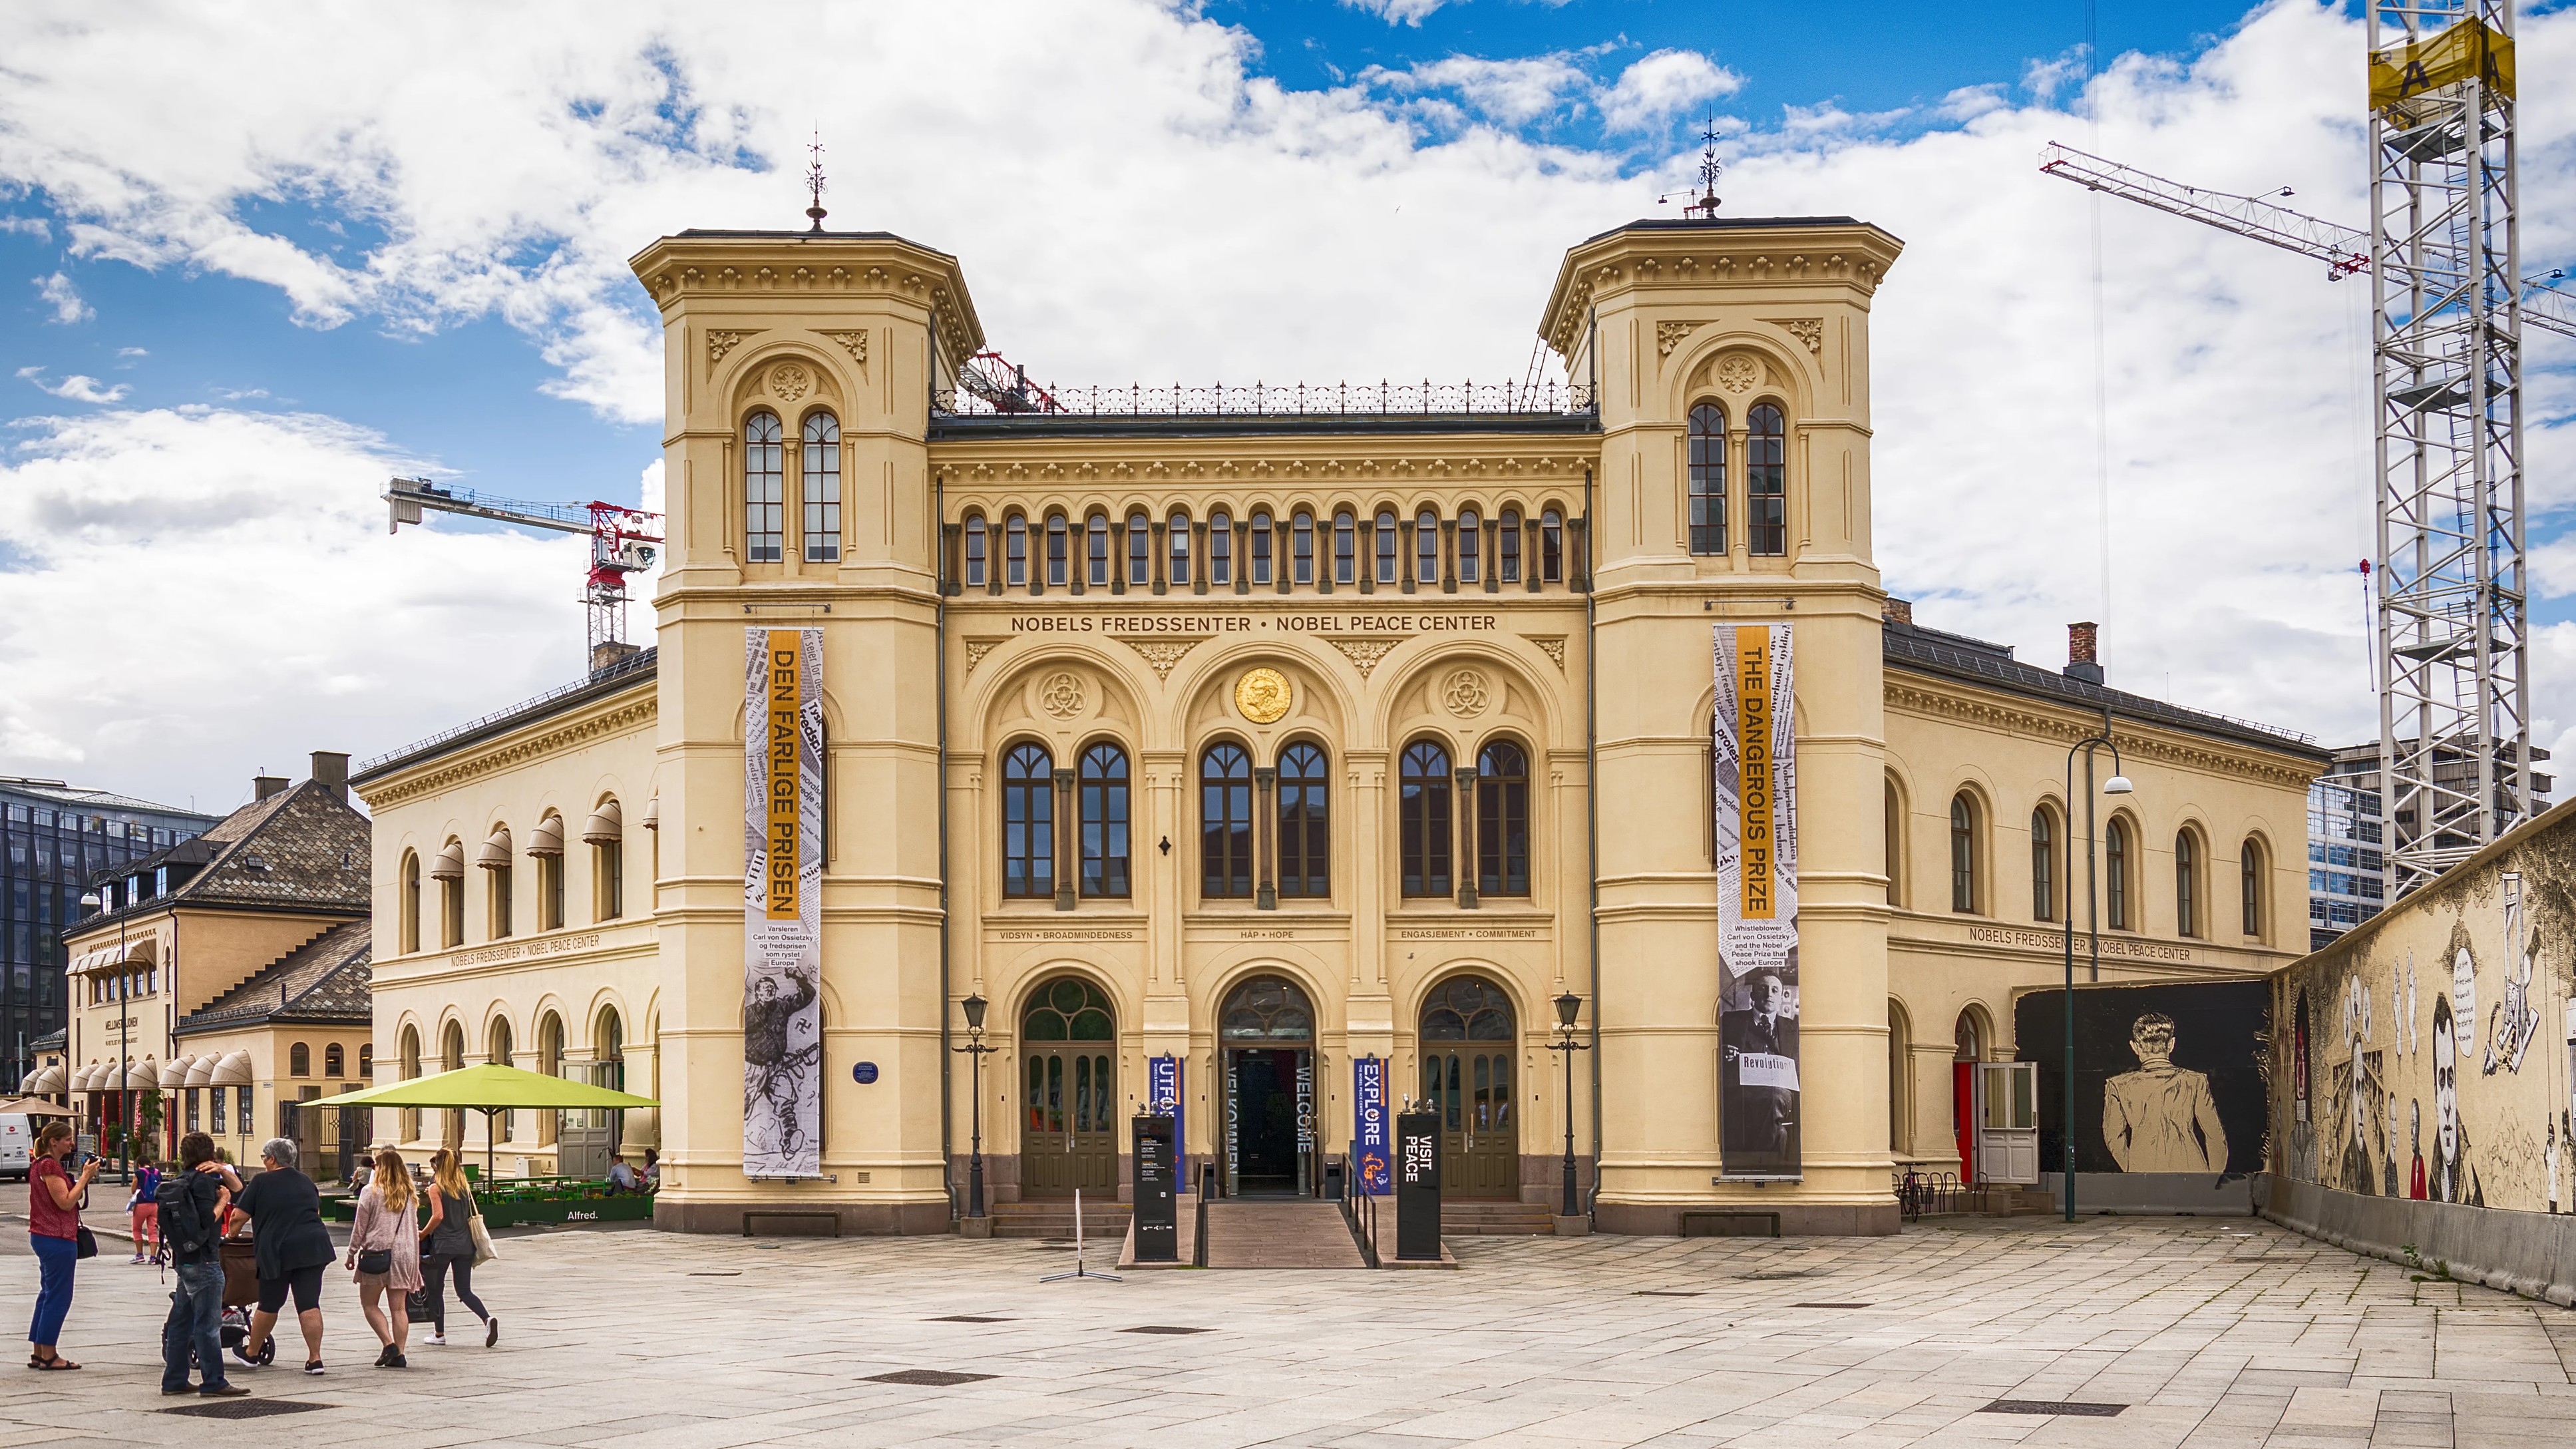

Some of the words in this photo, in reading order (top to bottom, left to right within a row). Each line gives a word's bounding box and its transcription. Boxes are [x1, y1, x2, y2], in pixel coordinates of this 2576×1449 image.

[1012, 616, 1093, 632] NOBELS
[1101, 616, 1251, 632] FREDSSENTER
[1276, 616, 1343, 631] NOBEL
[1350, 616, 1412, 631] PEACE
[1419, 616, 1495, 630] CENTER
[805, 642, 818, 662] seier
[811, 663, 822, 676] for
[1744, 646, 1763, 690] THE
[774, 650, 795, 701] DEN
[1771, 663, 1784, 712] overhodet
[754, 697, 767, 710] ikke
[756, 751, 767, 781] Ossietzky
[773, 710, 795, 813] FARLIGE
[1745, 698, 1766, 840] DANGEROUS
[1771, 763, 1783, 809] Ossietzky
[1782, 761, 1797, 860] Nobelpriskandidaten
[1775, 823, 1788, 861] livsfare.
[749, 855, 767, 880] FEIL
[773, 822, 795, 912] PRISEN
[1748, 847, 1767, 911] PRIZE
[1773, 863, 1785, 880] svar,
[451, 954, 474, 967] NOBELS
[476, 946, 520, 964] FREDSSENTER
[527, 942, 548, 956] NOBEL
[550, 938, 571, 952] PEACE
[572, 934, 600, 949] CENTER
[1240, 929, 1258, 938] HÅP
[1969, 927, 2012, 944] NOBELS
[2016, 932, 2086, 951] FREDSSENER
[2097, 940, 2126, 955] NOBEL
[2129, 944, 2155, 958] PEACE
[2157, 947, 2191, 961] CENTER
[1296, 1066, 1312, 1153] WELCOME
[1364, 1064, 1380, 1145] EXPLORE
[1405, 1136, 1418, 1182] PEACE
[1419, 1135, 1432, 1171] VISIT
[567, 1210, 598, 1220] Alfred.
